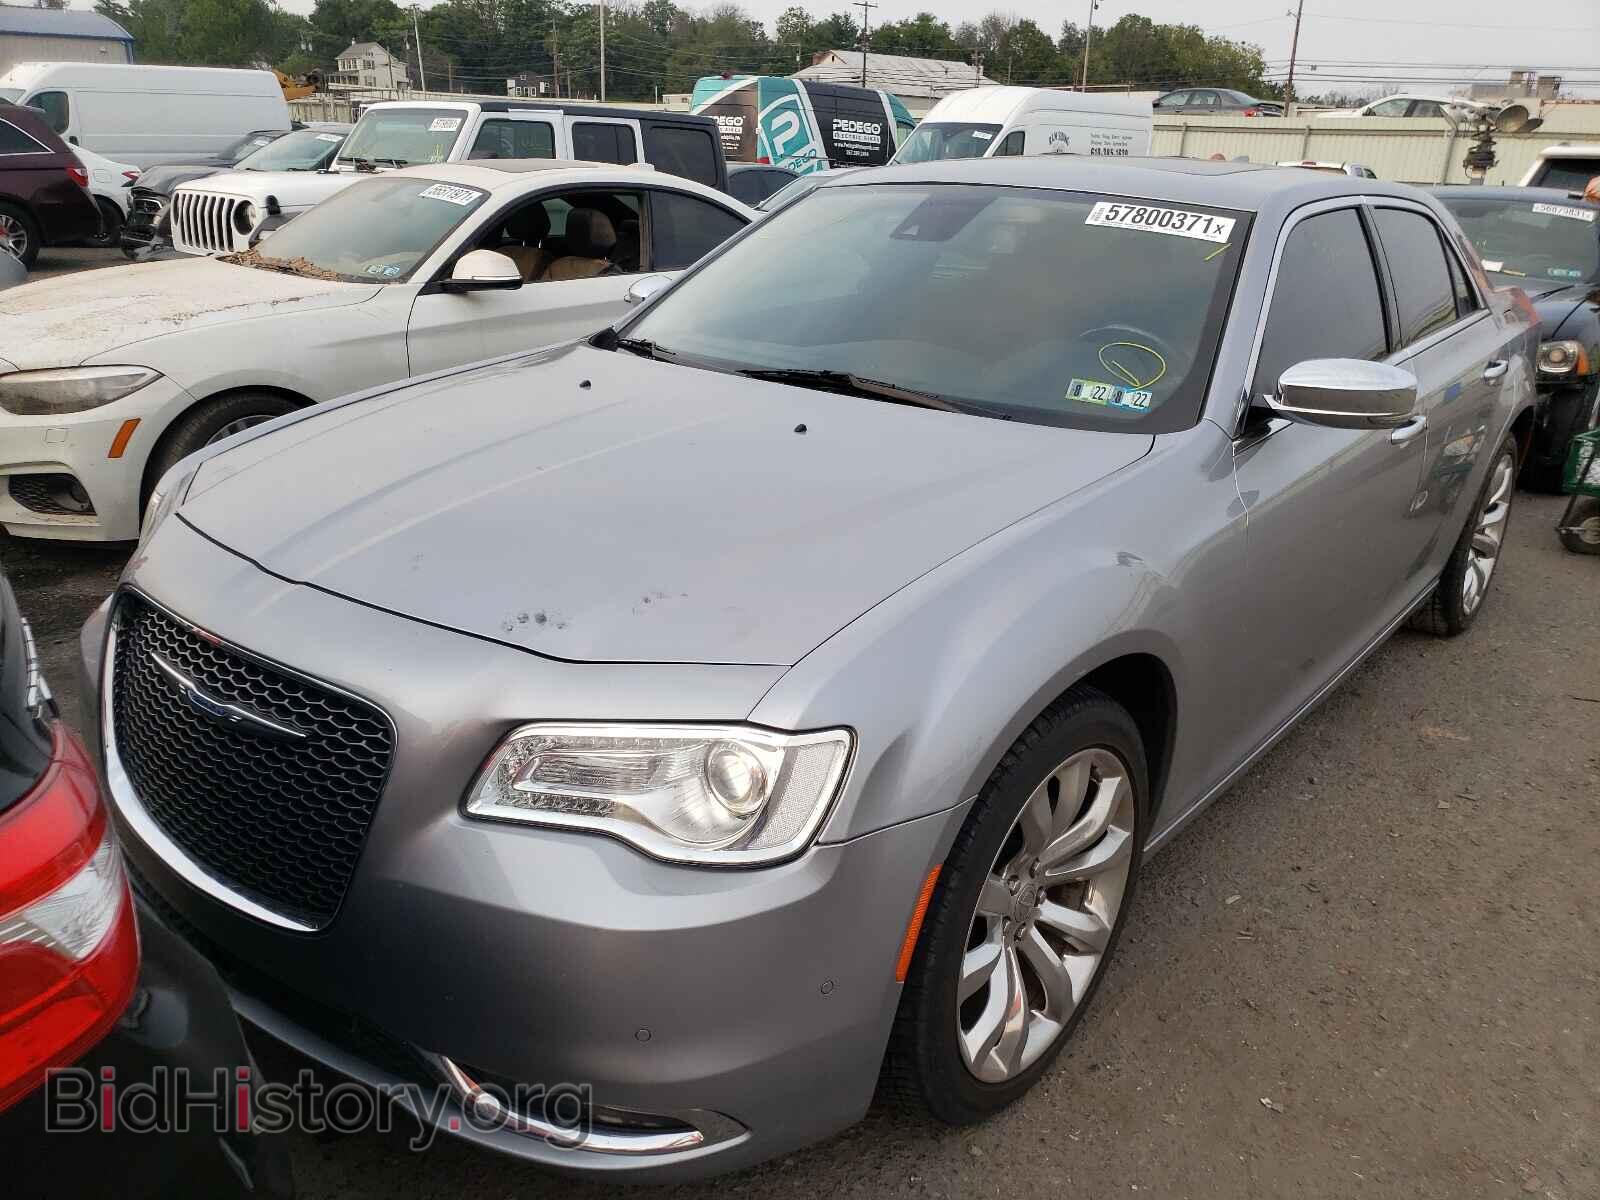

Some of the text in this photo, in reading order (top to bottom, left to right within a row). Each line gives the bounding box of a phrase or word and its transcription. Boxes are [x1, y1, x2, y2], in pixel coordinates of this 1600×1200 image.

[832, 118, 881, 135] PEDEGO
[1092, 385, 1107, 401] 22
[1133, 392, 1148, 408] 22
